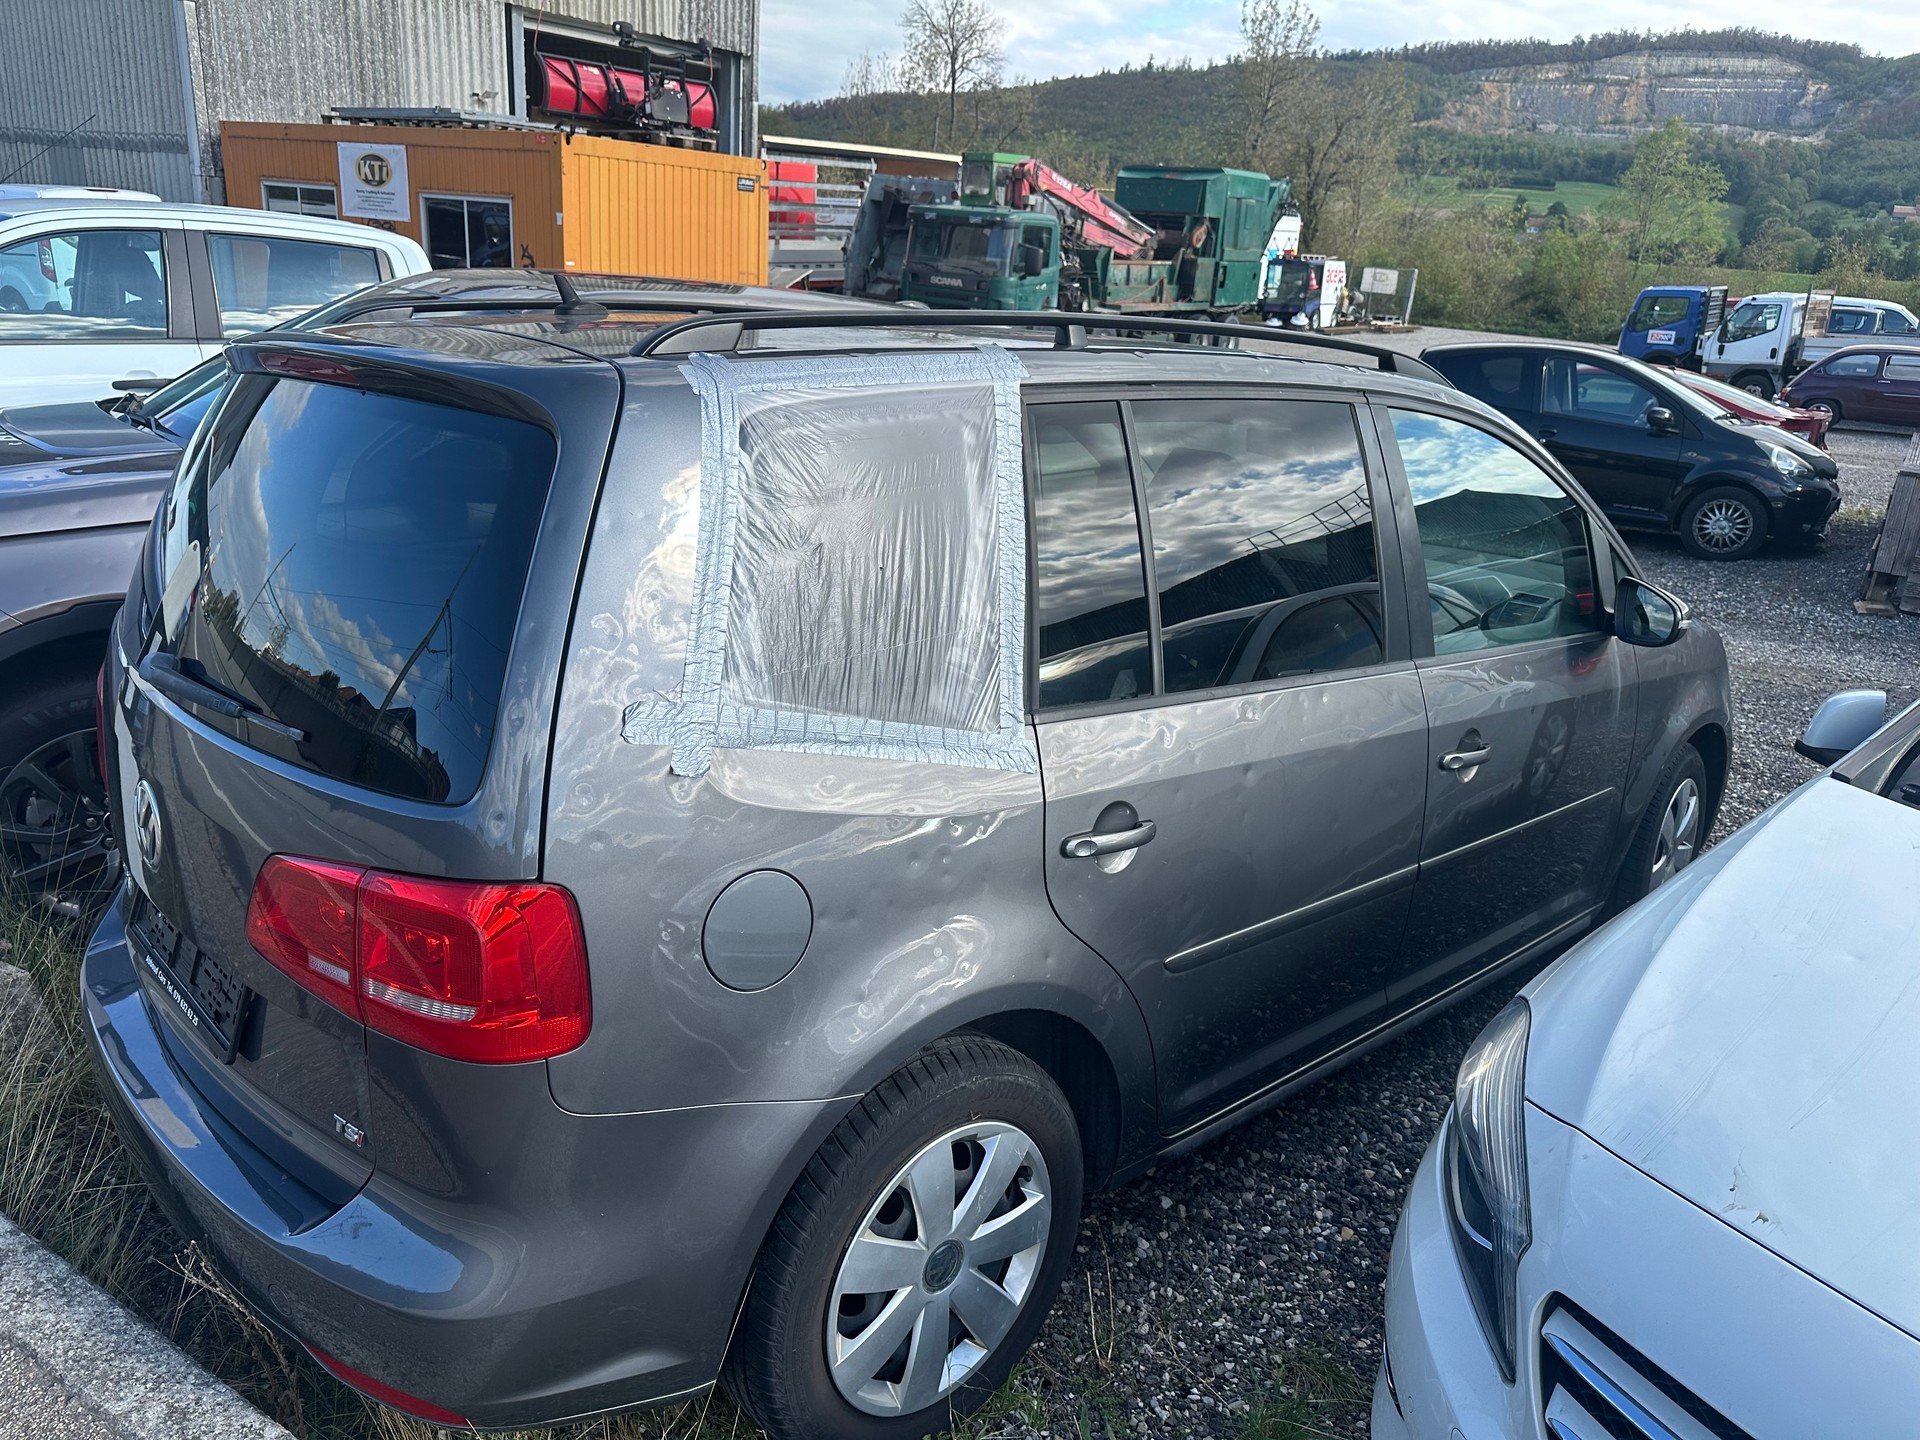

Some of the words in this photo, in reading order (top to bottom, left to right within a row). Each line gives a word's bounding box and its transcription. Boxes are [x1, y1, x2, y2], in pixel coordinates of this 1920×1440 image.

[930, 275, 963, 287] SCANIA
[157, 970, 166, 985] Cars
[172, 989, 181, 1004] 079
[179, 998, 188, 1013] 632
[187, 1008, 194, 1020] 62
[192, 1014, 199, 1027] 25
[333, 1113, 365, 1148] TSI
